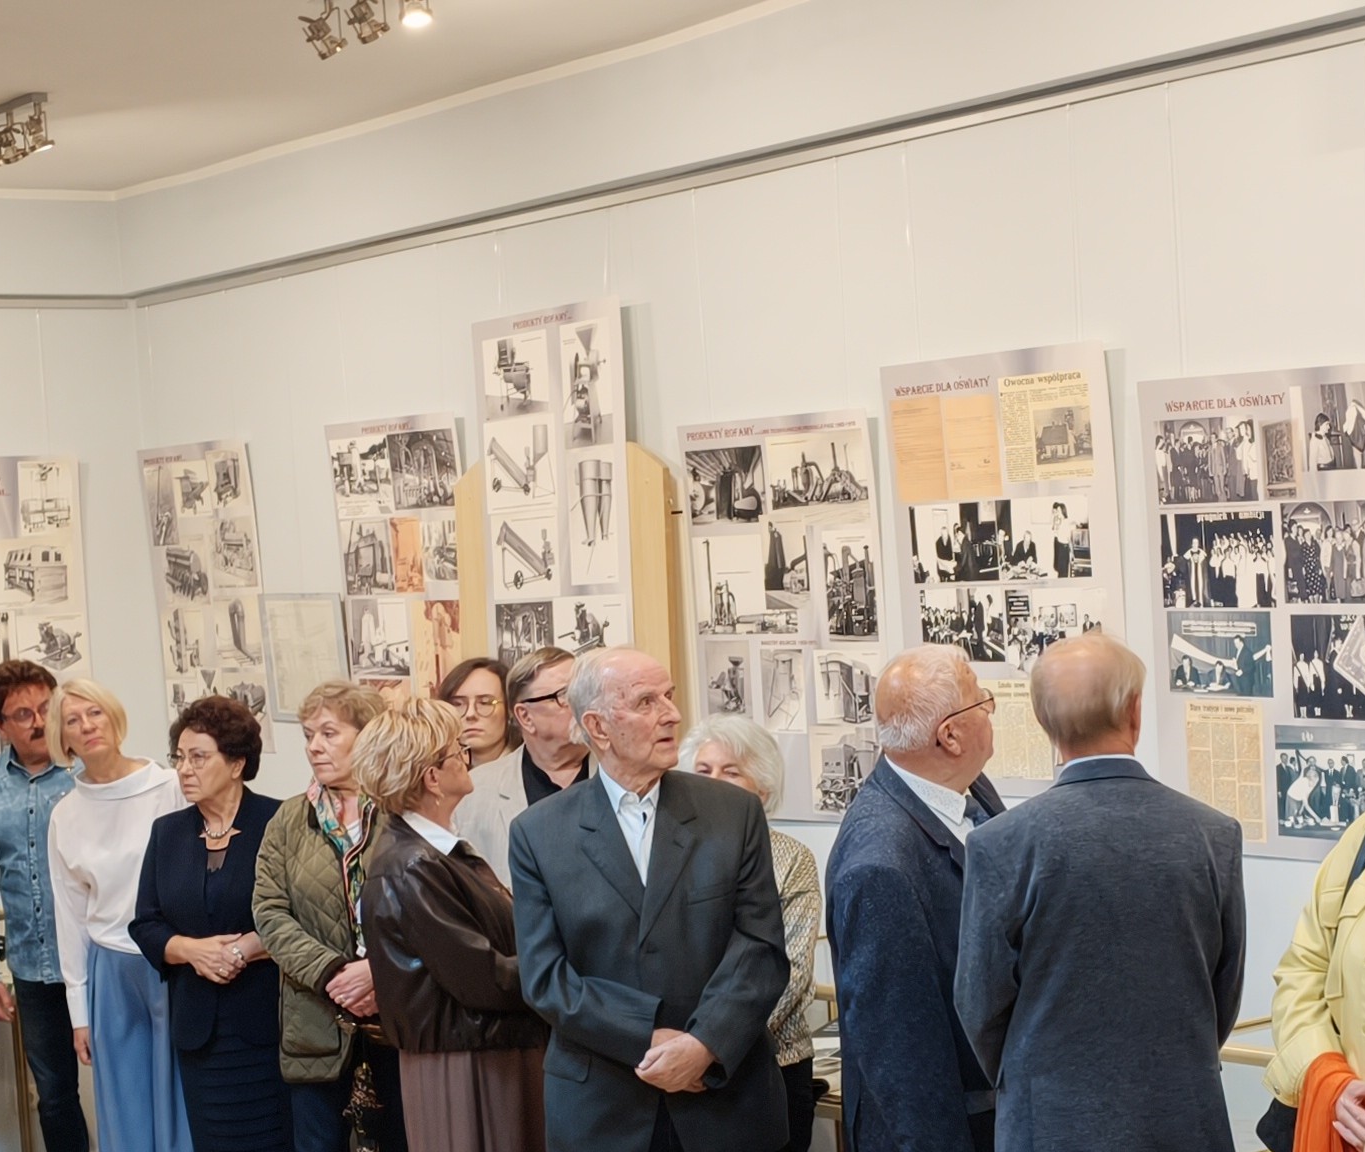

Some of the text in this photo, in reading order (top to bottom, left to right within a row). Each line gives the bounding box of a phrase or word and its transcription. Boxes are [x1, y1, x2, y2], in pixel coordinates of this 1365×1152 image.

[894, 375, 990, 397] WSPARCIE DLA OŚWIATY
[1003, 371, 1081, 388] Owocna współpraca
[1165, 391, 1285, 413] WSPARCIE DLA OŚWIATY
[686, 428, 722, 442] PRODUKTY
